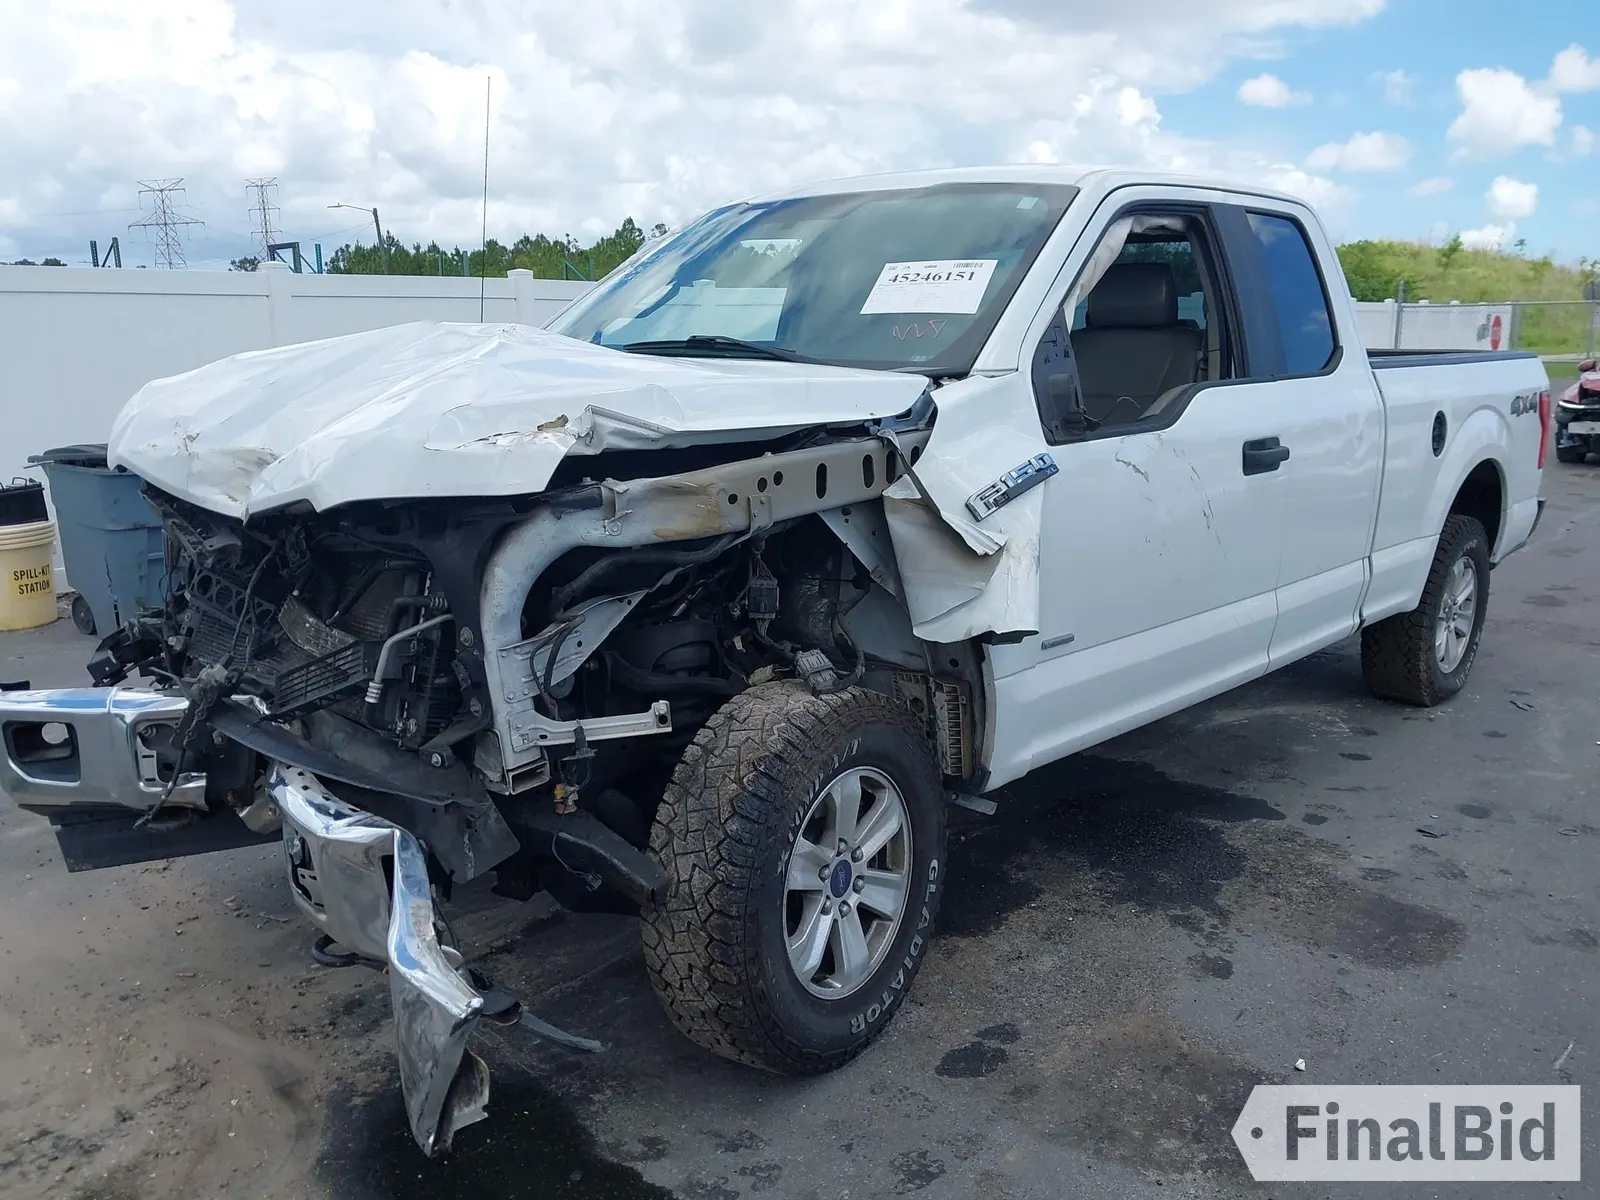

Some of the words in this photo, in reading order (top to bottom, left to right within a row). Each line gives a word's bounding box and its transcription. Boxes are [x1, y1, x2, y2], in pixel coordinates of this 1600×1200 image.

[888, 271, 976, 284] 45246151
[1046, 466, 1058, 475] XL
[13, 564, 50, 581] SPILL-KIT
[18, 579, 51, 595] STATION
[850, 858, 939, 1034] GLADIATOR
